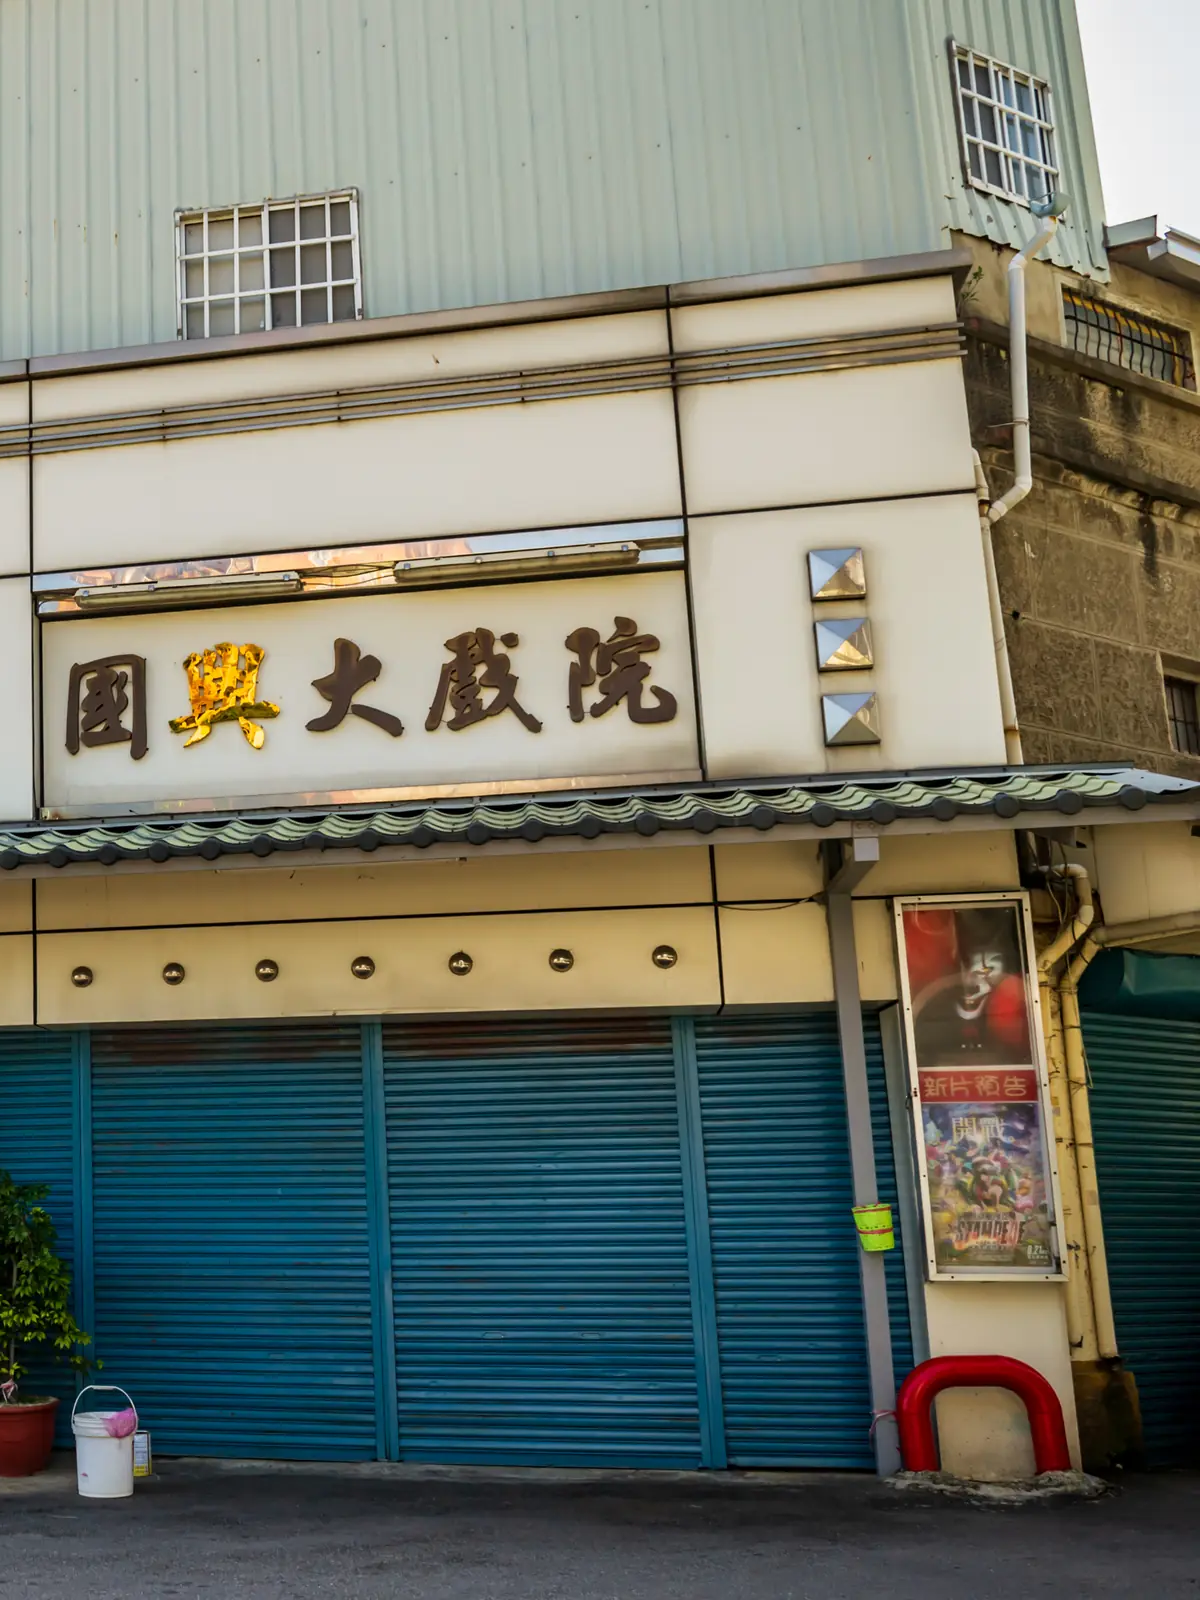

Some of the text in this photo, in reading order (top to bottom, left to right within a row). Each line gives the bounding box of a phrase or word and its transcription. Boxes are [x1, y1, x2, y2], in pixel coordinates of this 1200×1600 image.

[64, 615, 678, 760] 國興大戲院
[923, 1074, 1027, 1098] 新片預告
